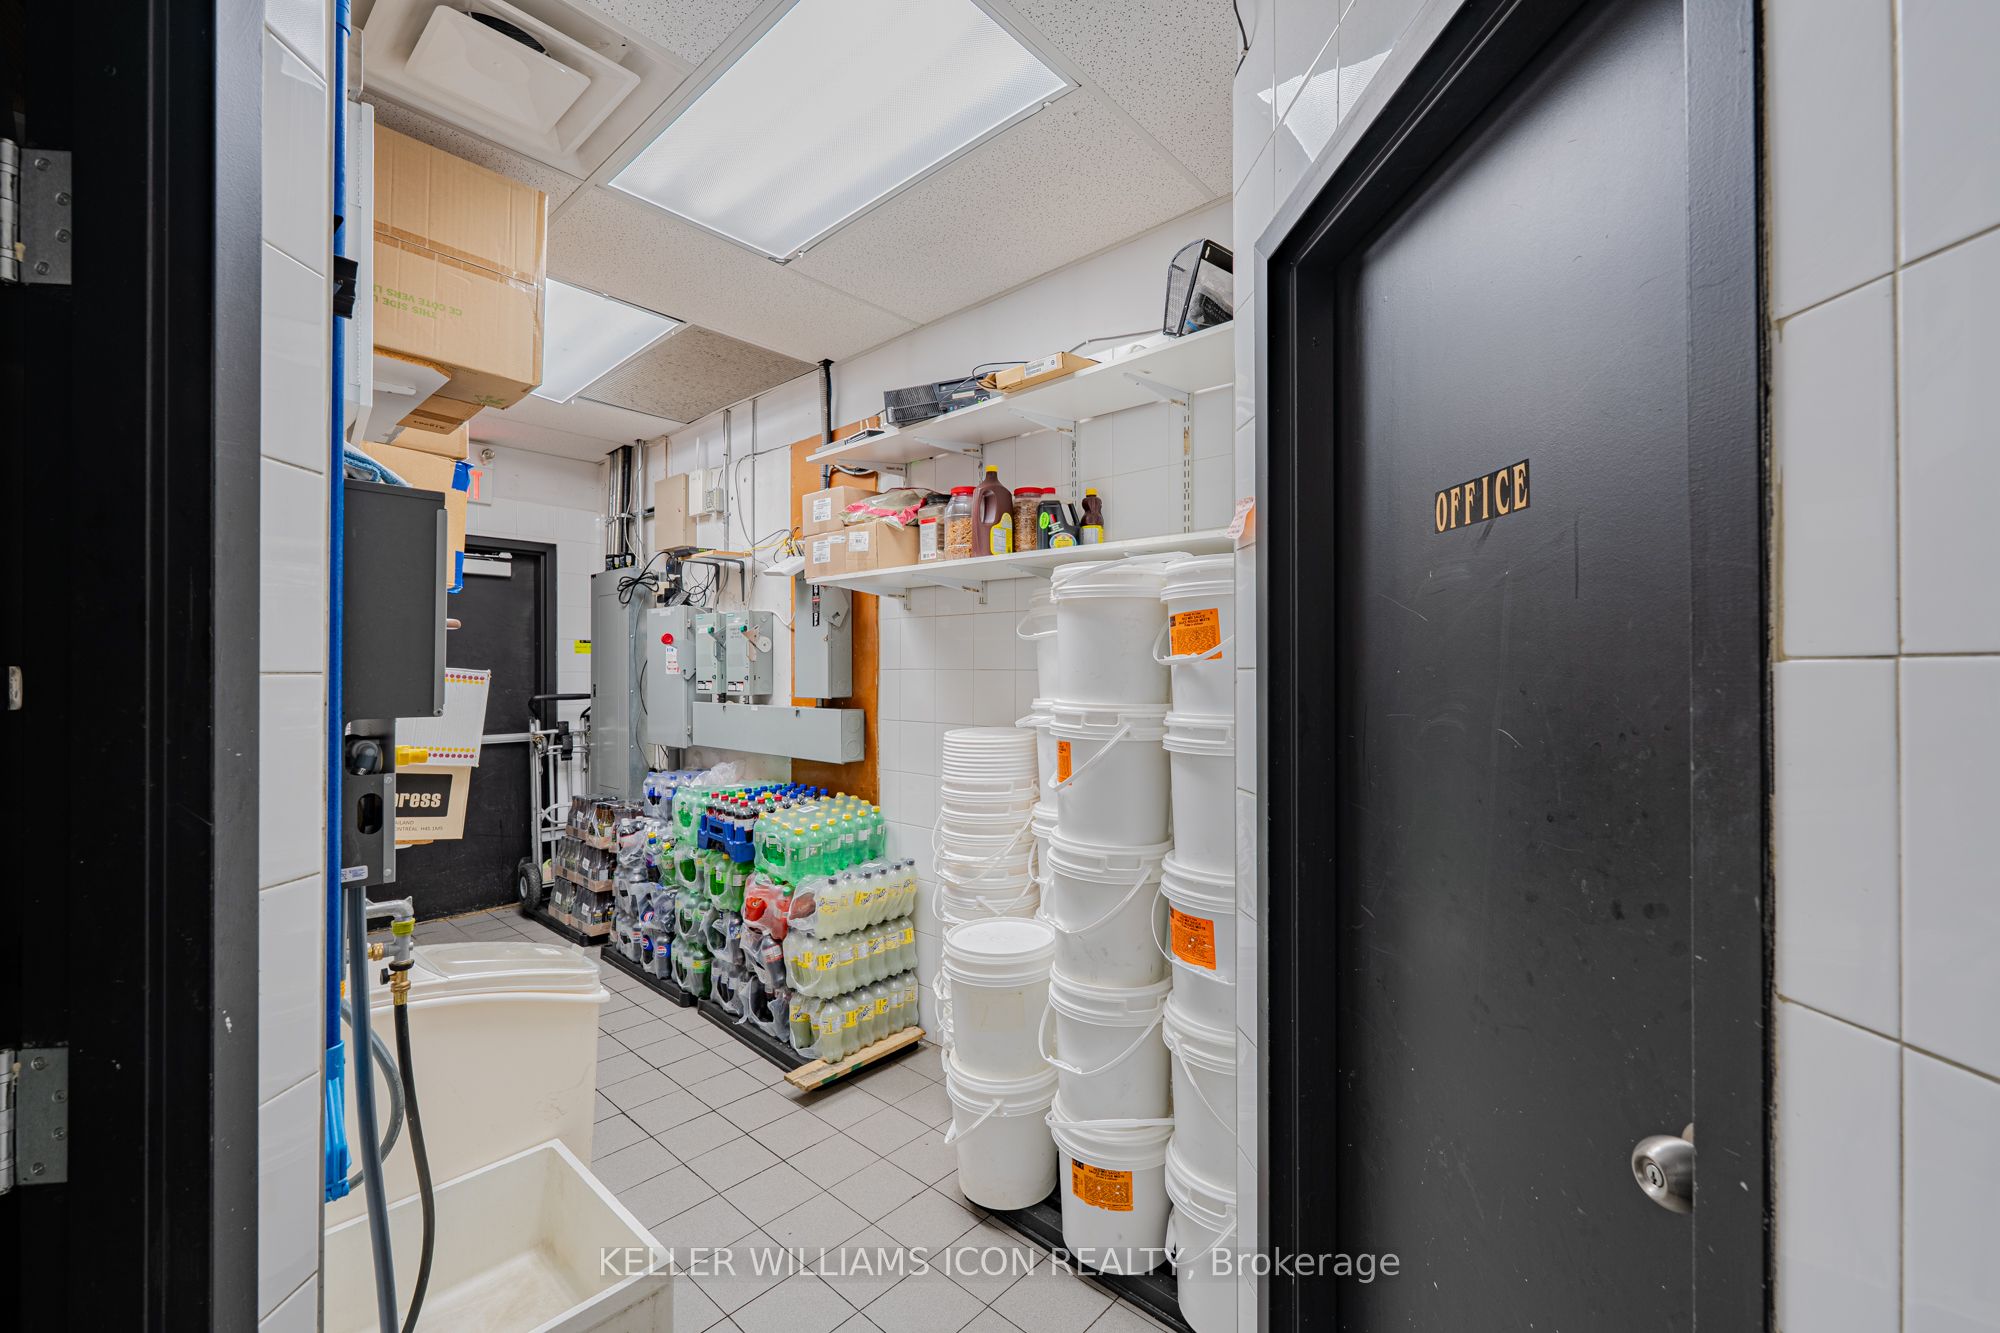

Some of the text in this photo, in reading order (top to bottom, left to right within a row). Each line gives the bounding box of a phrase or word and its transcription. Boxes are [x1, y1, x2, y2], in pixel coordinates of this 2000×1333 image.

[386, 287, 415, 303] VERS
[383, 297, 408, 311] SIDE
[412, 306, 437, 320] THIS
[1435, 462, 1528, 532] OFFICE
